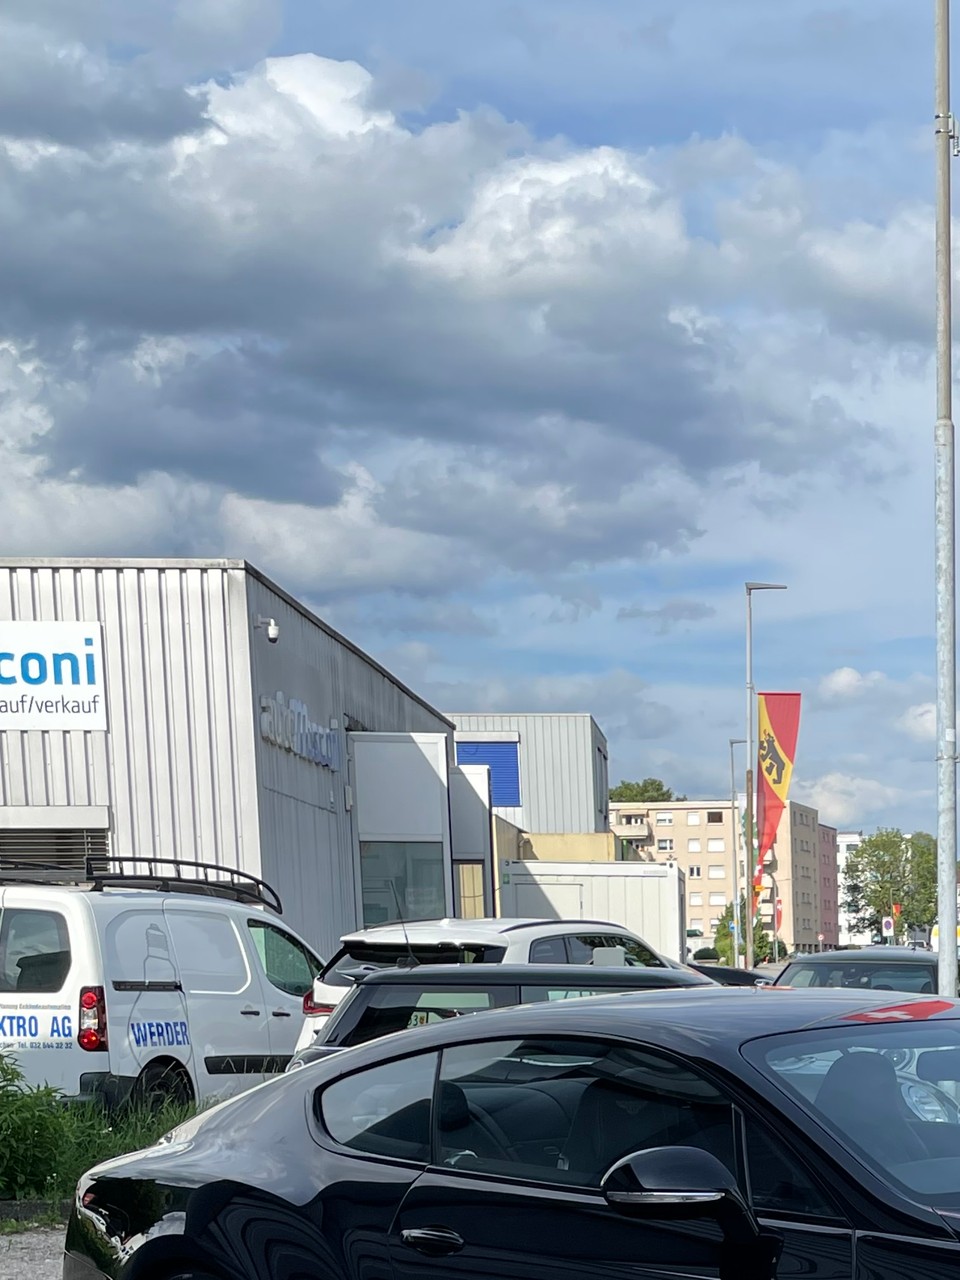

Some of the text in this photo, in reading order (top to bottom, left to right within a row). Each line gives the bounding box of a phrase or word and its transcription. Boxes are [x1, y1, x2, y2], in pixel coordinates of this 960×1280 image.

[0, 637, 96, 686] coni
[0, 694, 100, 714] auf/verkauf
[50, 1015, 73, 1038] AG
[130, 1021, 190, 1047] WERDER
